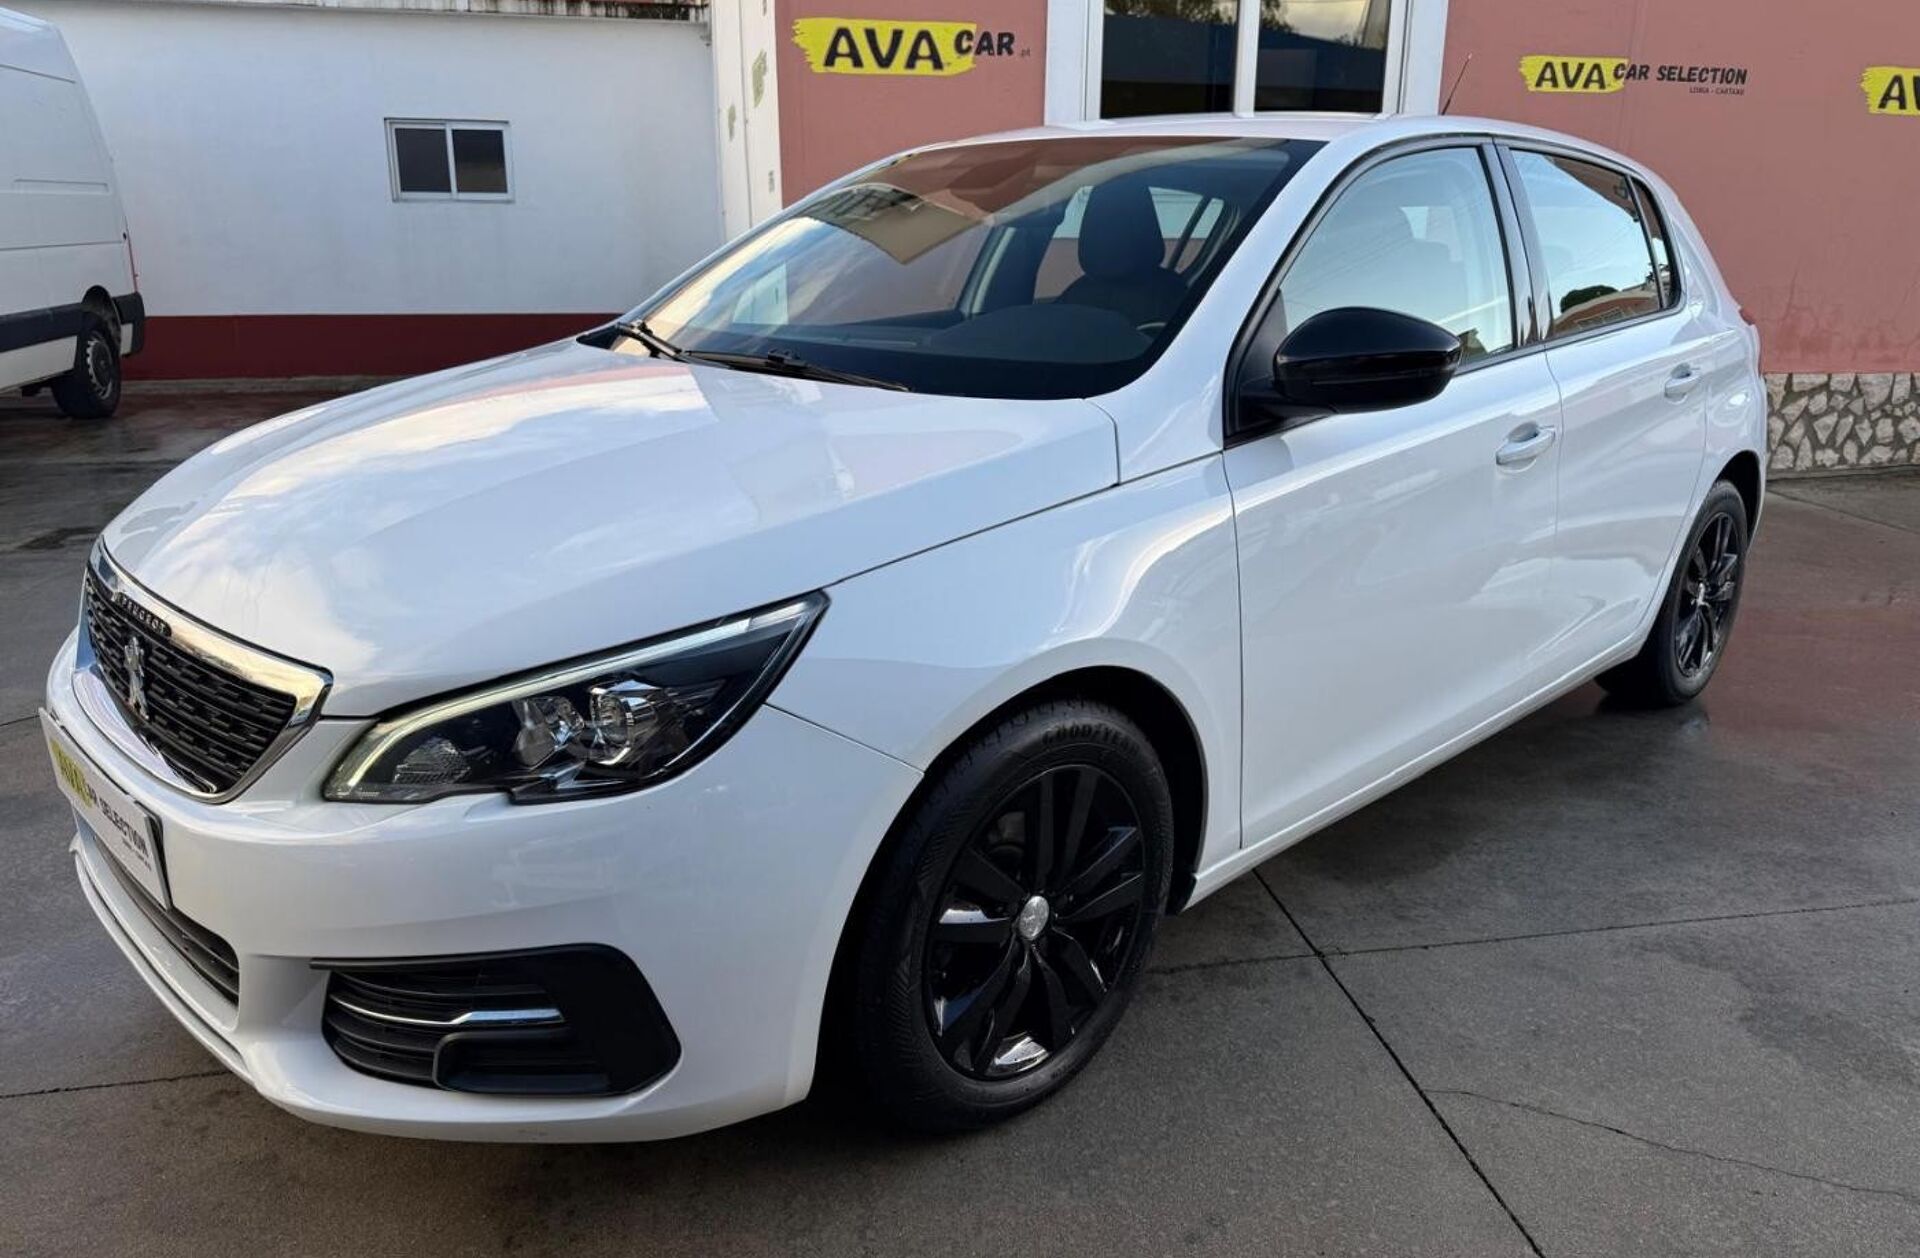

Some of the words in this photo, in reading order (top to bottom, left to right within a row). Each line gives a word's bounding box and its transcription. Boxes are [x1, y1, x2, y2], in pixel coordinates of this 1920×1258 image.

[823, 27, 944, 70] AVA
[953, 30, 1015, 56] CAR
[1535, 61, 1607, 89] AVA
[1613, 63, 1650, 80] CAR
[1656, 65, 1747, 85] SELECTION
[99, 796, 149, 859] SELECTION
